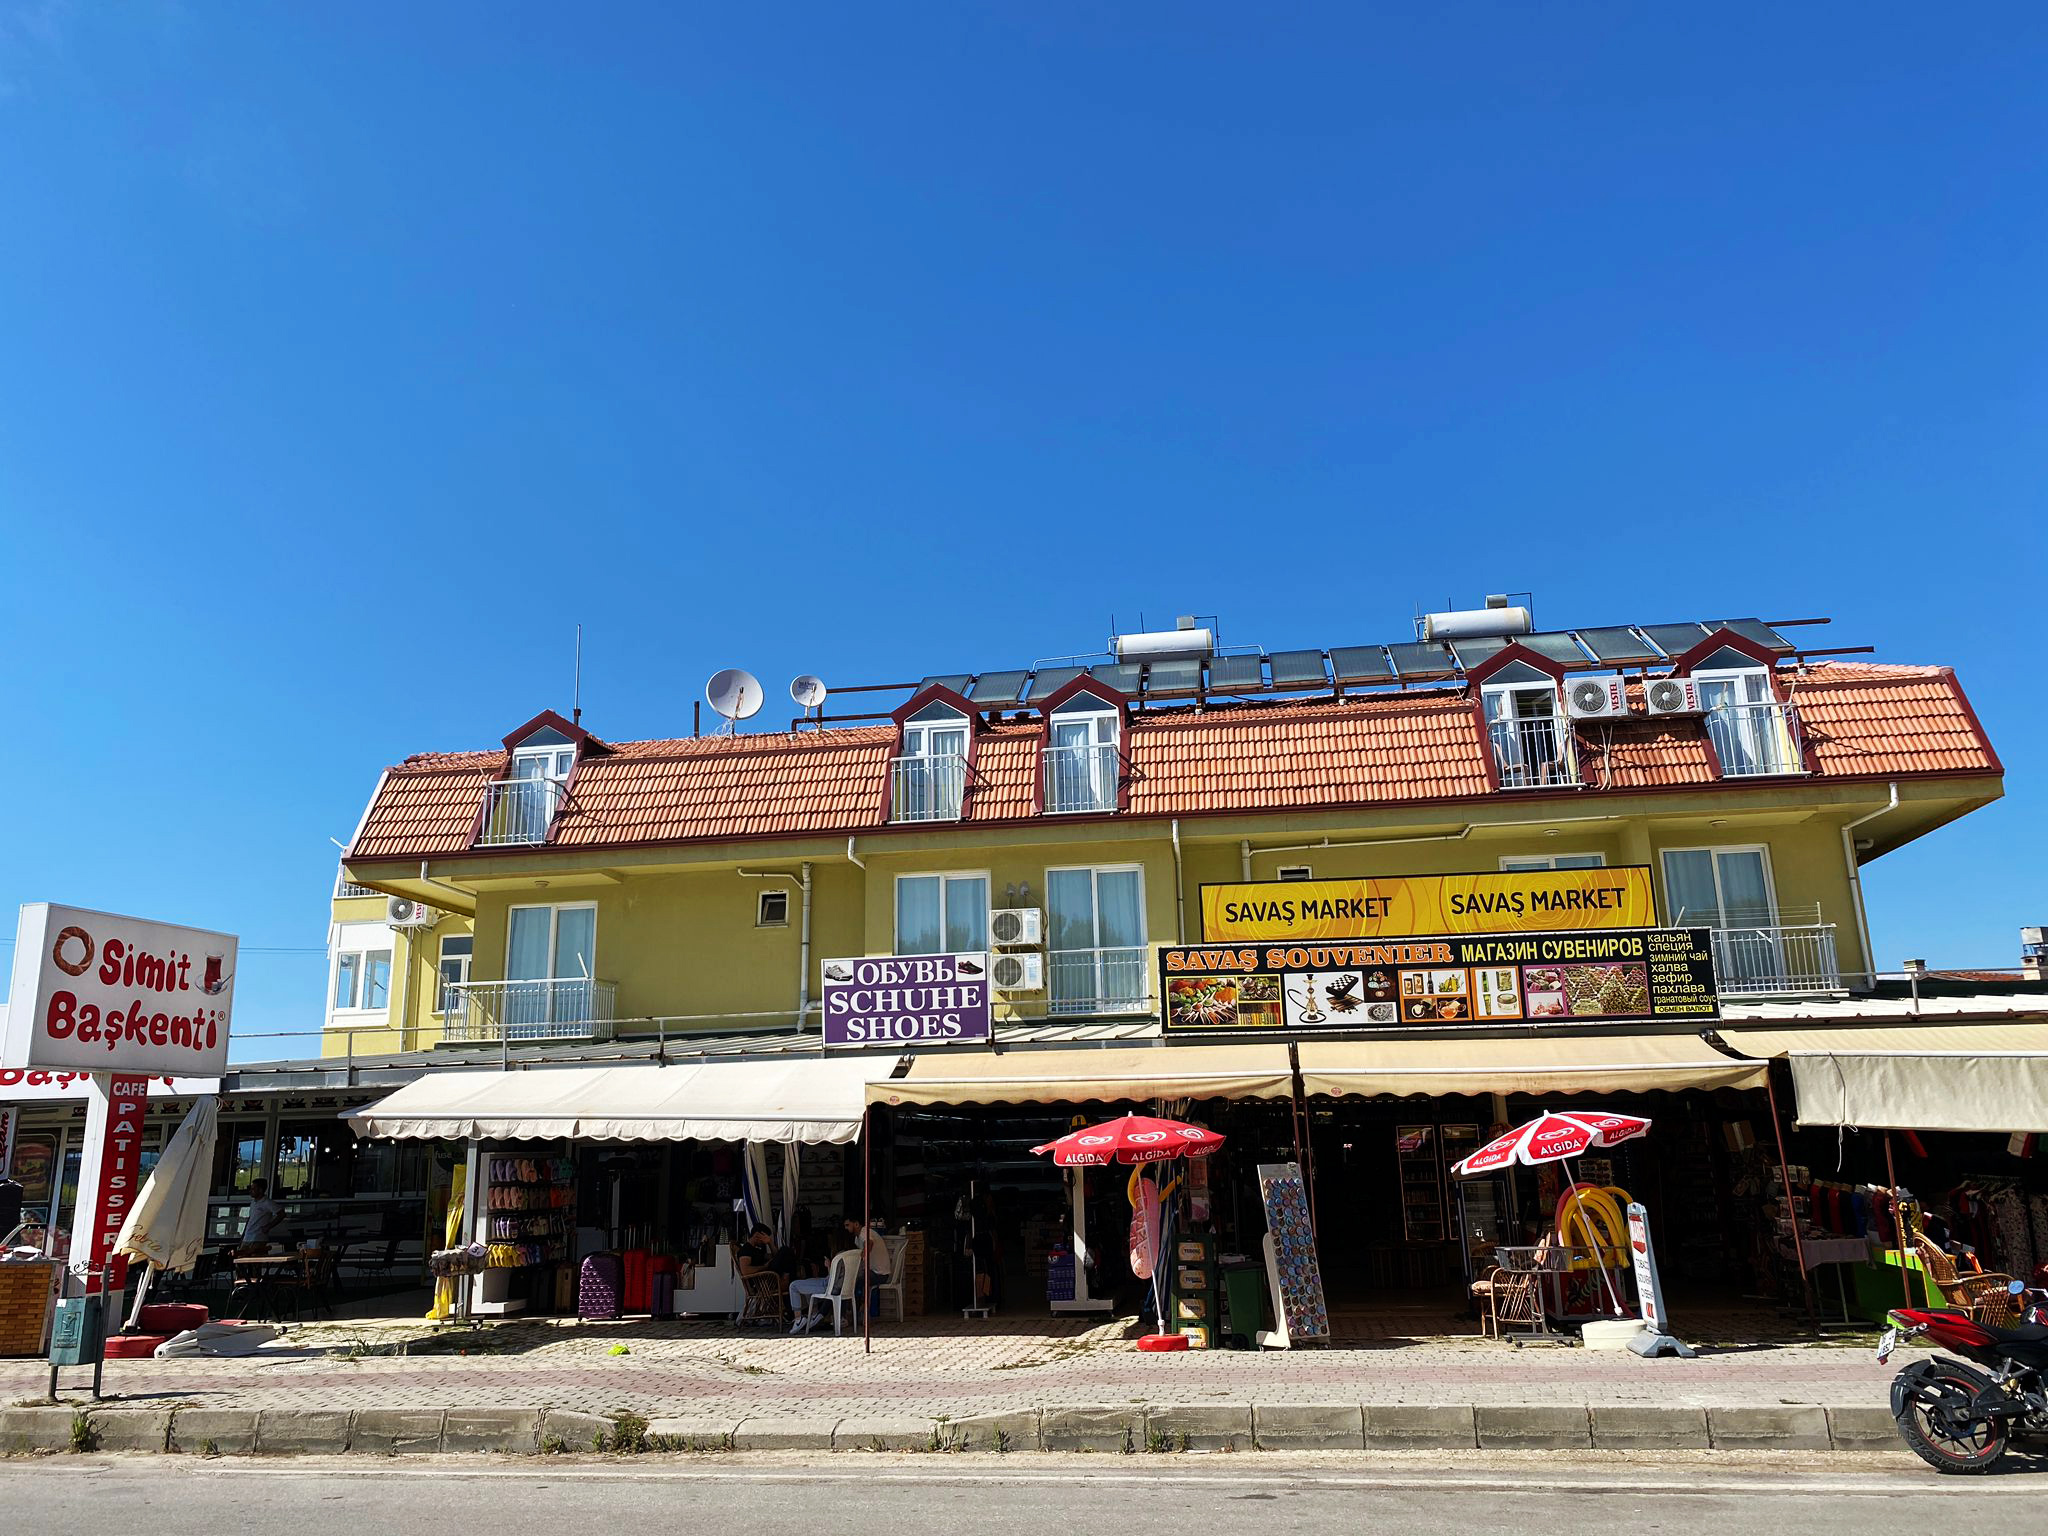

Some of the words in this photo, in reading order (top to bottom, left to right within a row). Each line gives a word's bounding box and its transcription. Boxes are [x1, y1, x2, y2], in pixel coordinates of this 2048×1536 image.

[1609, 682, 1619, 710] VESTEL
[1685, 683, 1695, 709] VESTEL
[1225, 901, 1295, 926] SAVAŞ
[1302, 896, 1392, 920] MARKET
[1450, 892, 1525, 917] SAVAŞ
[1532, 887, 1626, 912] MARKET
[1461, 941, 1538, 962] МАГАЗИН
[1541, 937, 1644, 959] СУВЕНИРОВ
[1647, 933, 1692, 943] кальян
[1648, 942, 1694, 952] специя
[99, 938, 191, 992] Simit
[1166, 949, 1258, 972] SAVAŞ
[1266, 943, 1454, 968] SOUVENIER
[1649, 951, 1687, 962] зимний
[1689, 950, 1708, 961] чай
[1651, 963, 1689, 973] халва
[857, 959, 954, 986] ОБУВЬ
[1651, 971, 1693, 984] зефир
[829, 985, 982, 1014] SCHUHE
[1652, 984, 1706, 994] пахлава
[1653, 993, 1698, 1005] гранатовый
[1699, 994, 1717, 1004] соус
[47, 991, 217, 1051] Başkenti
[1658, 1005, 1685, 1013] ОБМЕН
[847, 1013, 962, 1041] SHOES
[113, 1081, 145, 1097] CAFE
